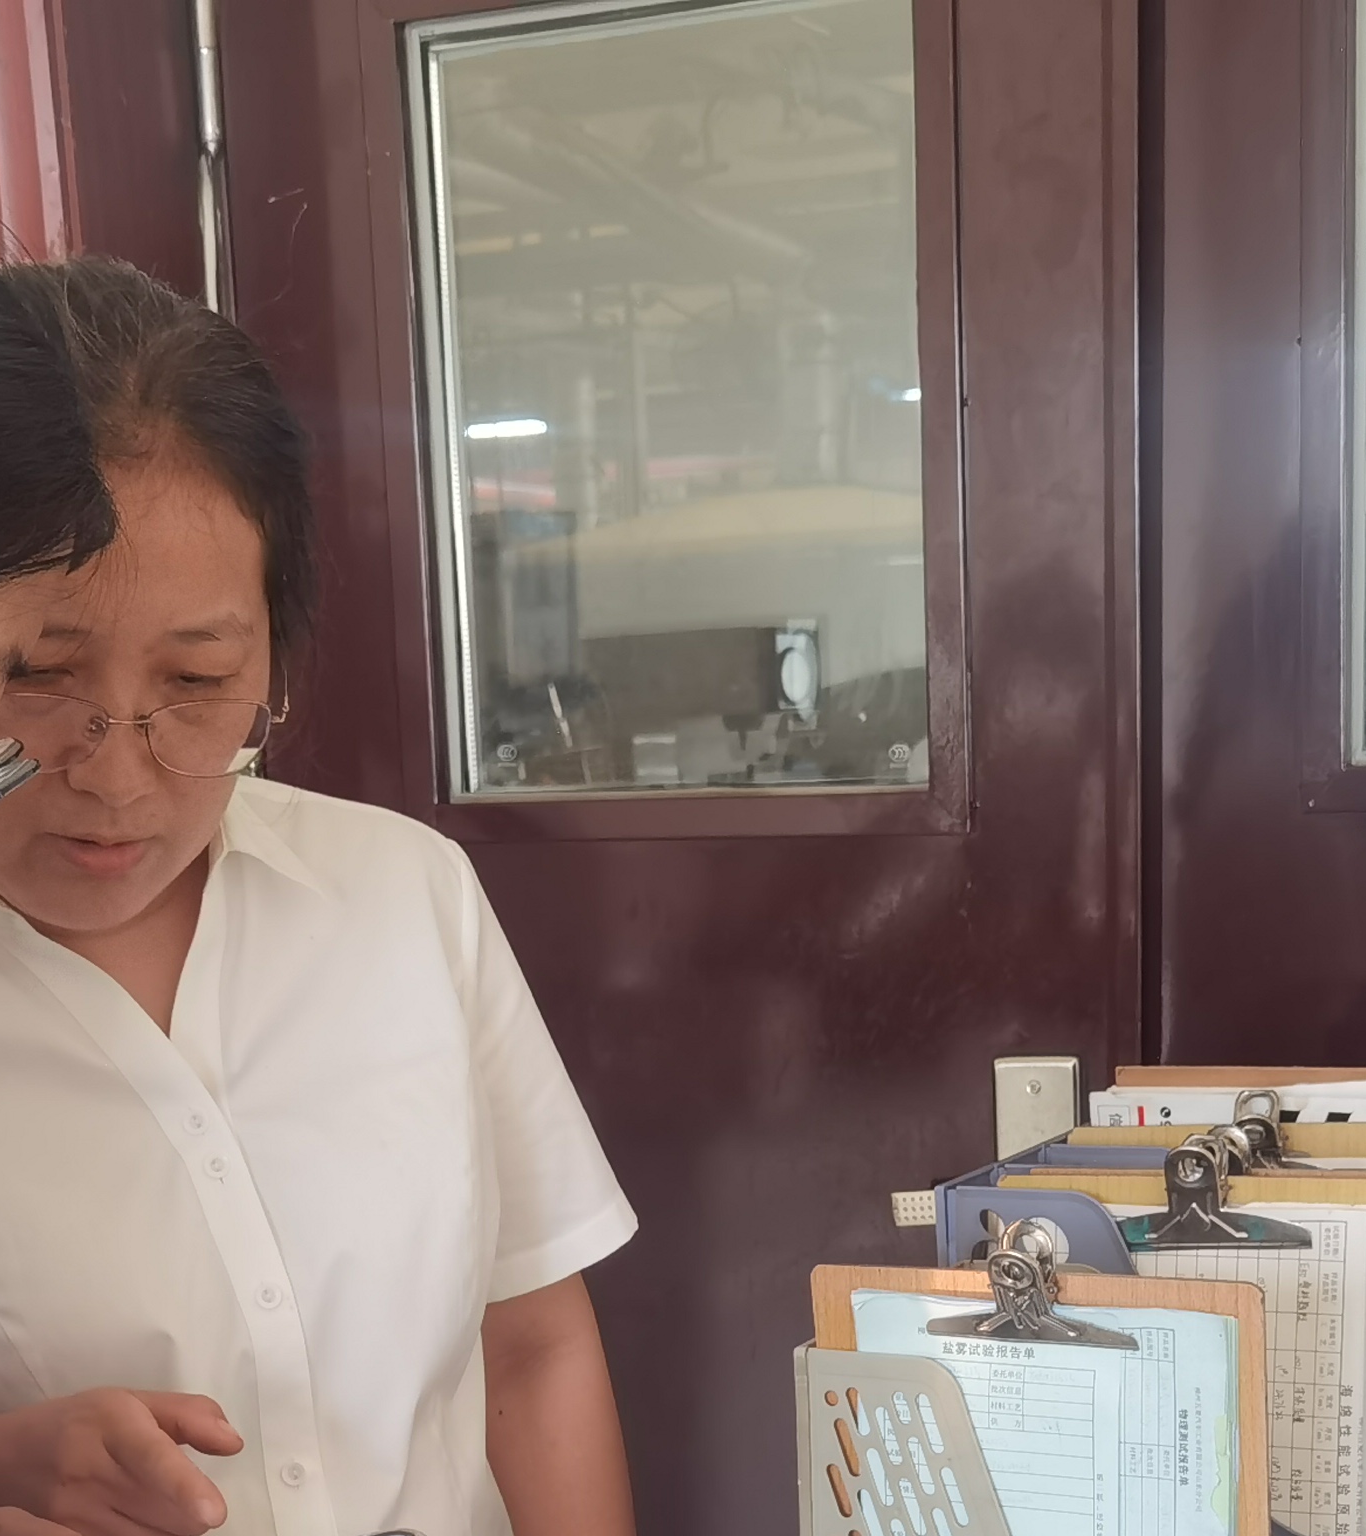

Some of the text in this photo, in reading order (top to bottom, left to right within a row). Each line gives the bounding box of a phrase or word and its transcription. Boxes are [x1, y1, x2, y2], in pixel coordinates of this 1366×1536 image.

[942, 1341, 1036, 1360] 盐雾试验报告单
[992, 1370, 1023, 1380] 委托单位
[990, 1401, 1022, 1412] 材料工艺
[1178, 1409, 1188, 1487] 物理测试报告单
